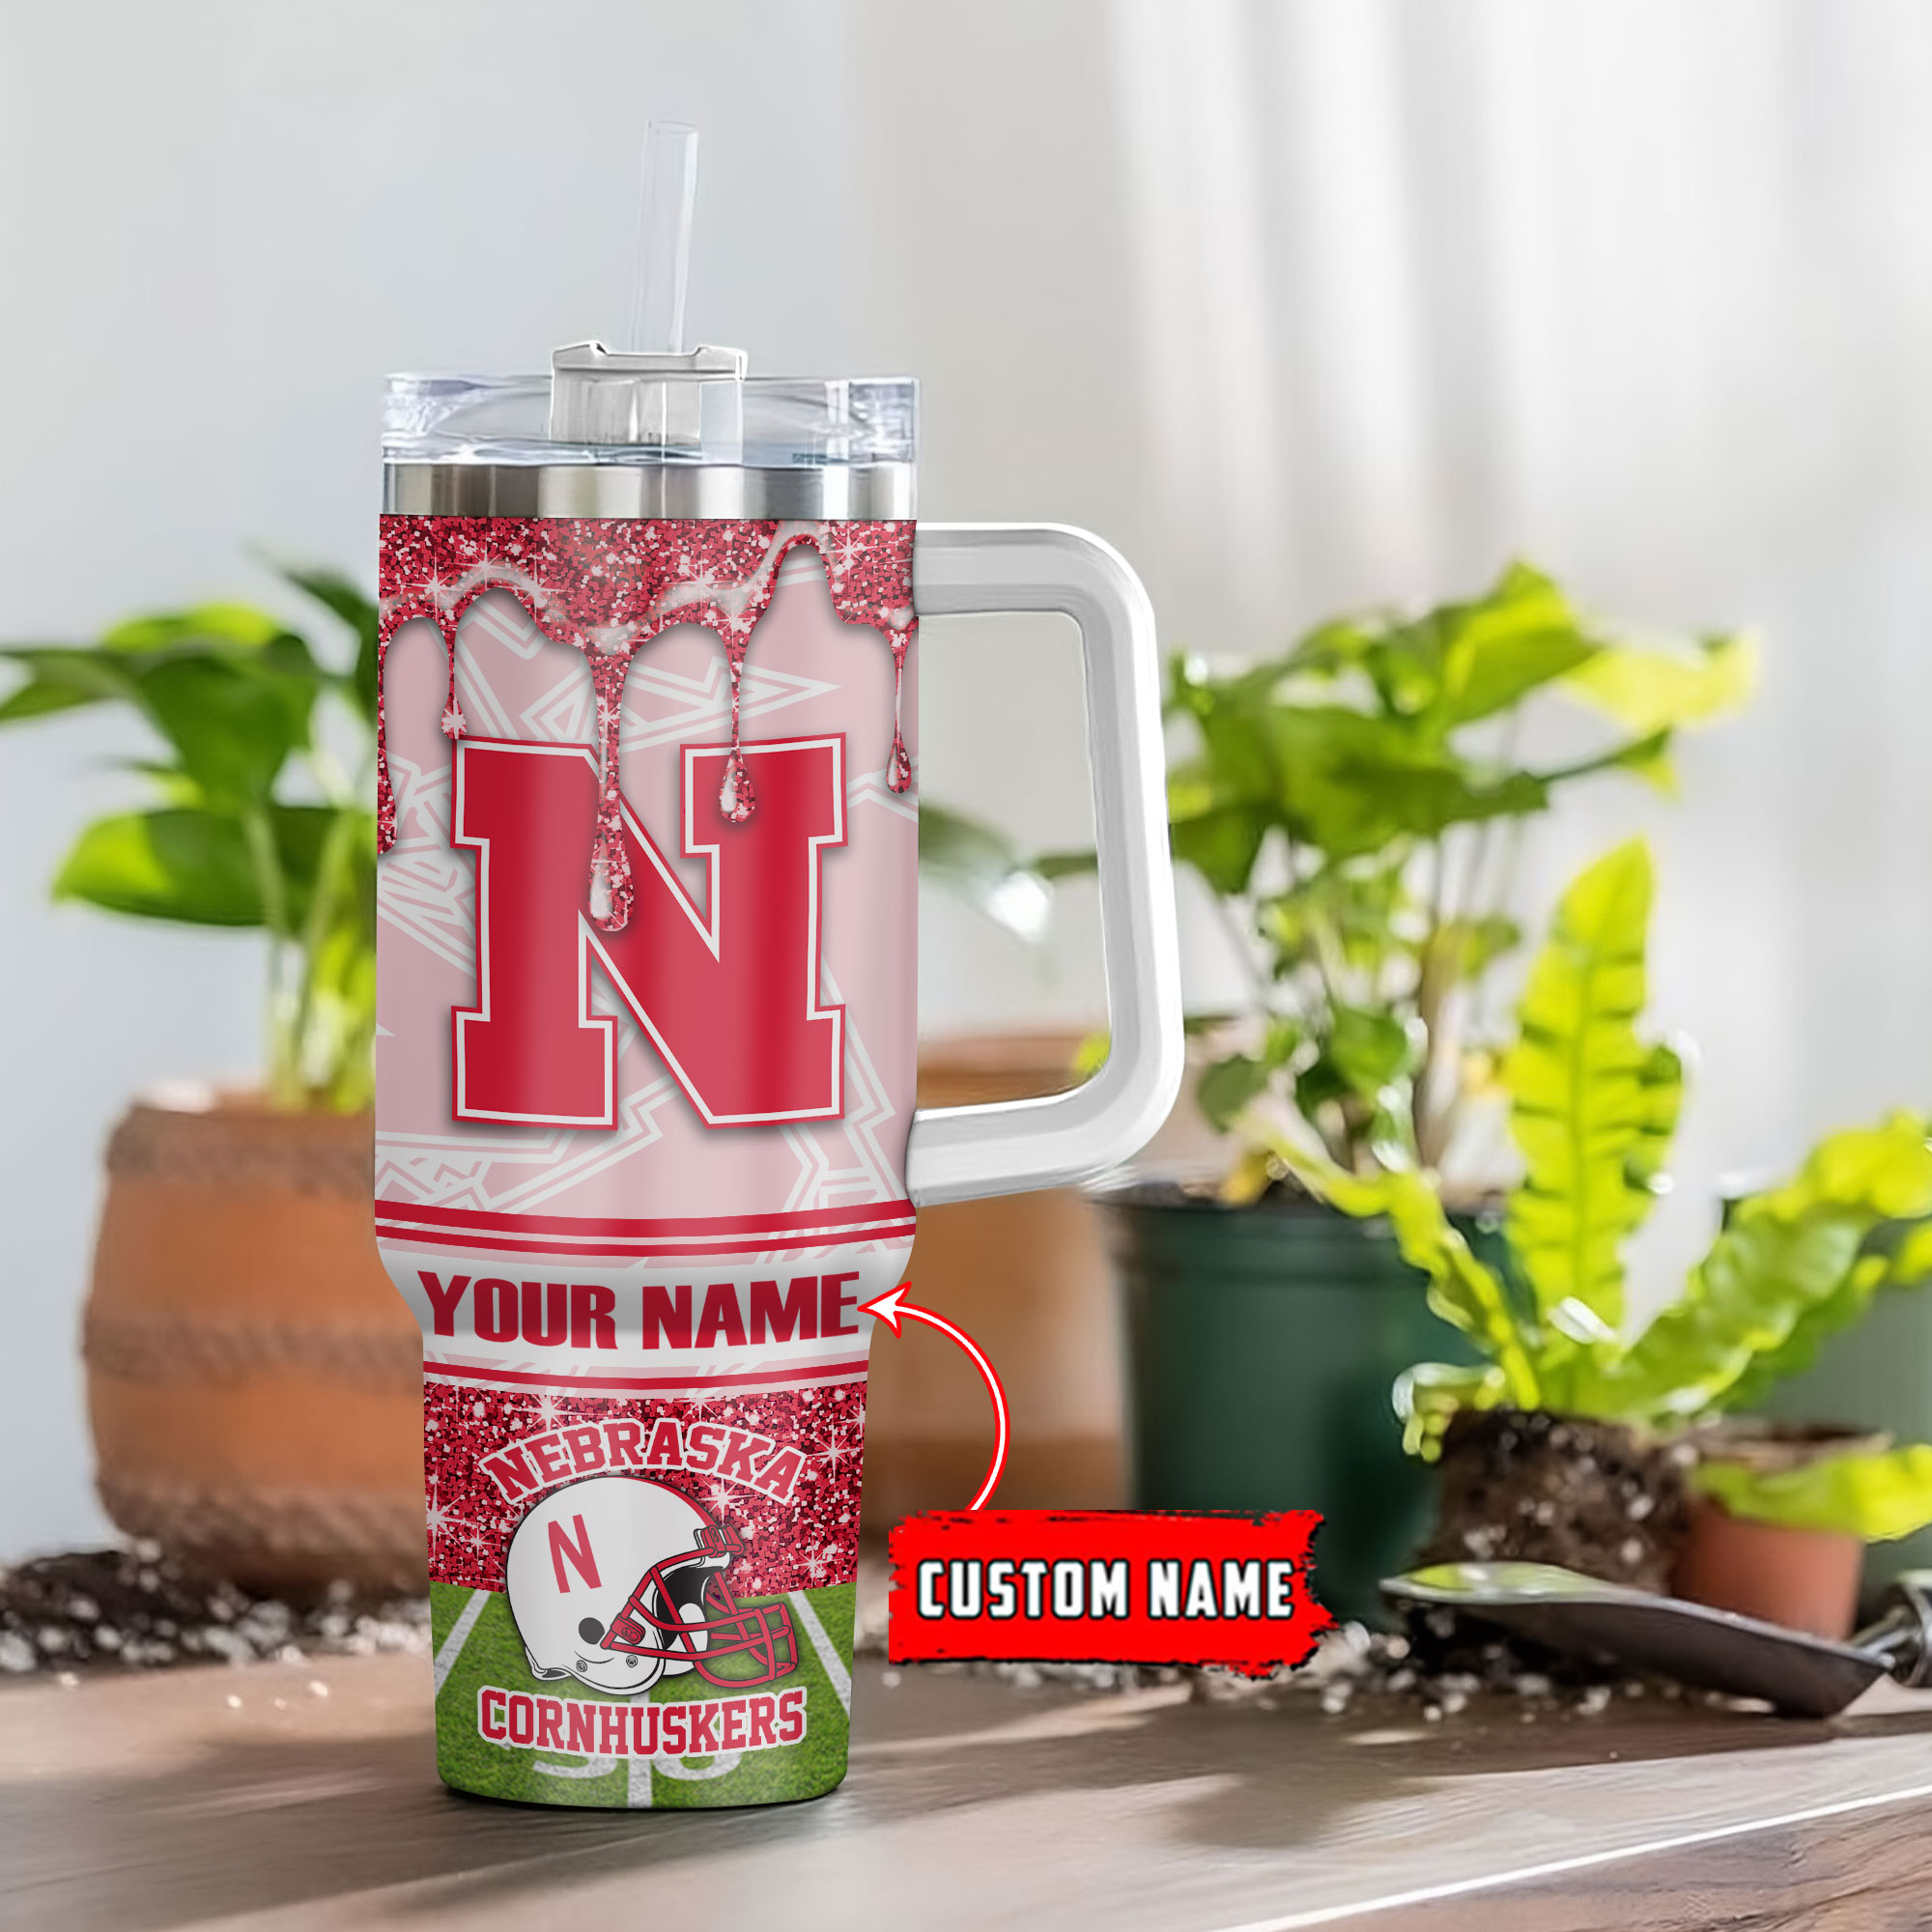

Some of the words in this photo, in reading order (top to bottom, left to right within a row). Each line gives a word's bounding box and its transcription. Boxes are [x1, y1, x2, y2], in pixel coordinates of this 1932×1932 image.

[451, 732, 848, 1130] N
[417, 1270, 618, 1350] YOUR
[641, 1271, 860, 1350] NAME
[481, 1420, 807, 1502] NEBRASKA
[547, 1514, 603, 1594] N
[479, 1689, 805, 1756] CORNHUSKERS
